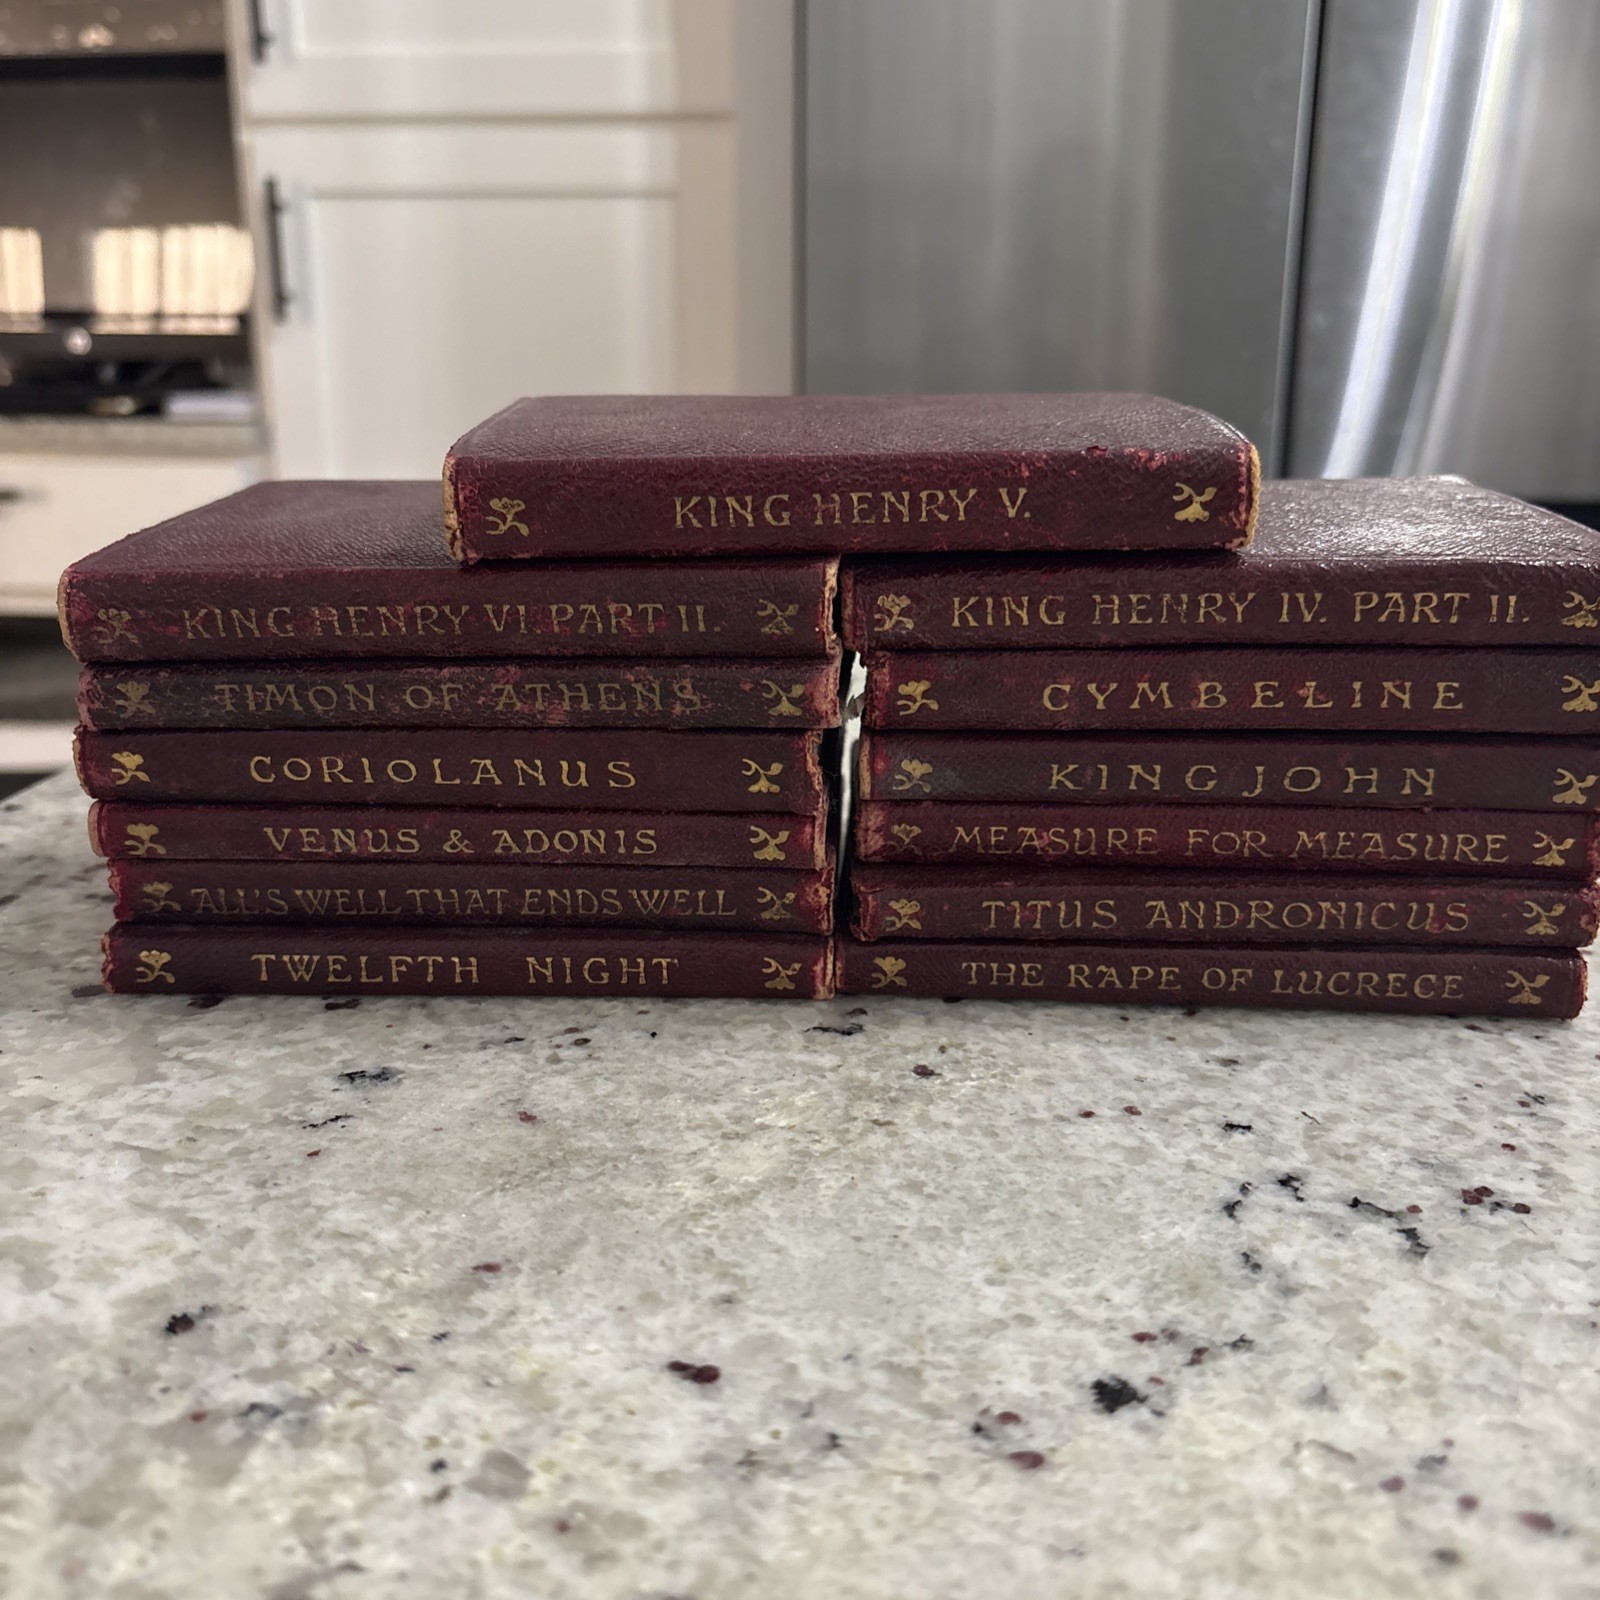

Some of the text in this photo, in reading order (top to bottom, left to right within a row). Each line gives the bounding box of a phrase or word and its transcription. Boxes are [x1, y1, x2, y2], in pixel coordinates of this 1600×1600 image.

[674, 488, 1031, 528] KING HENRY V.
[182, 607, 295, 639] KING
[310, 605, 470, 636] HENRY
[550, 603, 664, 634] PART
[677, 605, 721, 633] II.
[951, 591, 1530, 627] KING HENRY IV. PART II.
[214, 683, 701, 712] TIMON OF ATHENS
[1042, 681, 1464, 710] CYMBELINE
[250, 755, 637, 788] CORIOLANUS
[1047, 764, 1436, 797] KING JOHN
[263, 827, 658, 854] VENUS & ADONIS
[952, 826, 1509, 862] MEASURE FOR MEASURE
[191, 888, 737, 916] ALL'S WELL THAT ENDS WELL
[981, 900, 1470, 931] TITUS ANDRONICUS
[251, 954, 679, 985] TWELFTH NIGHT
[961, 962, 1464, 1000] THE RAPE OF LUCRECE
